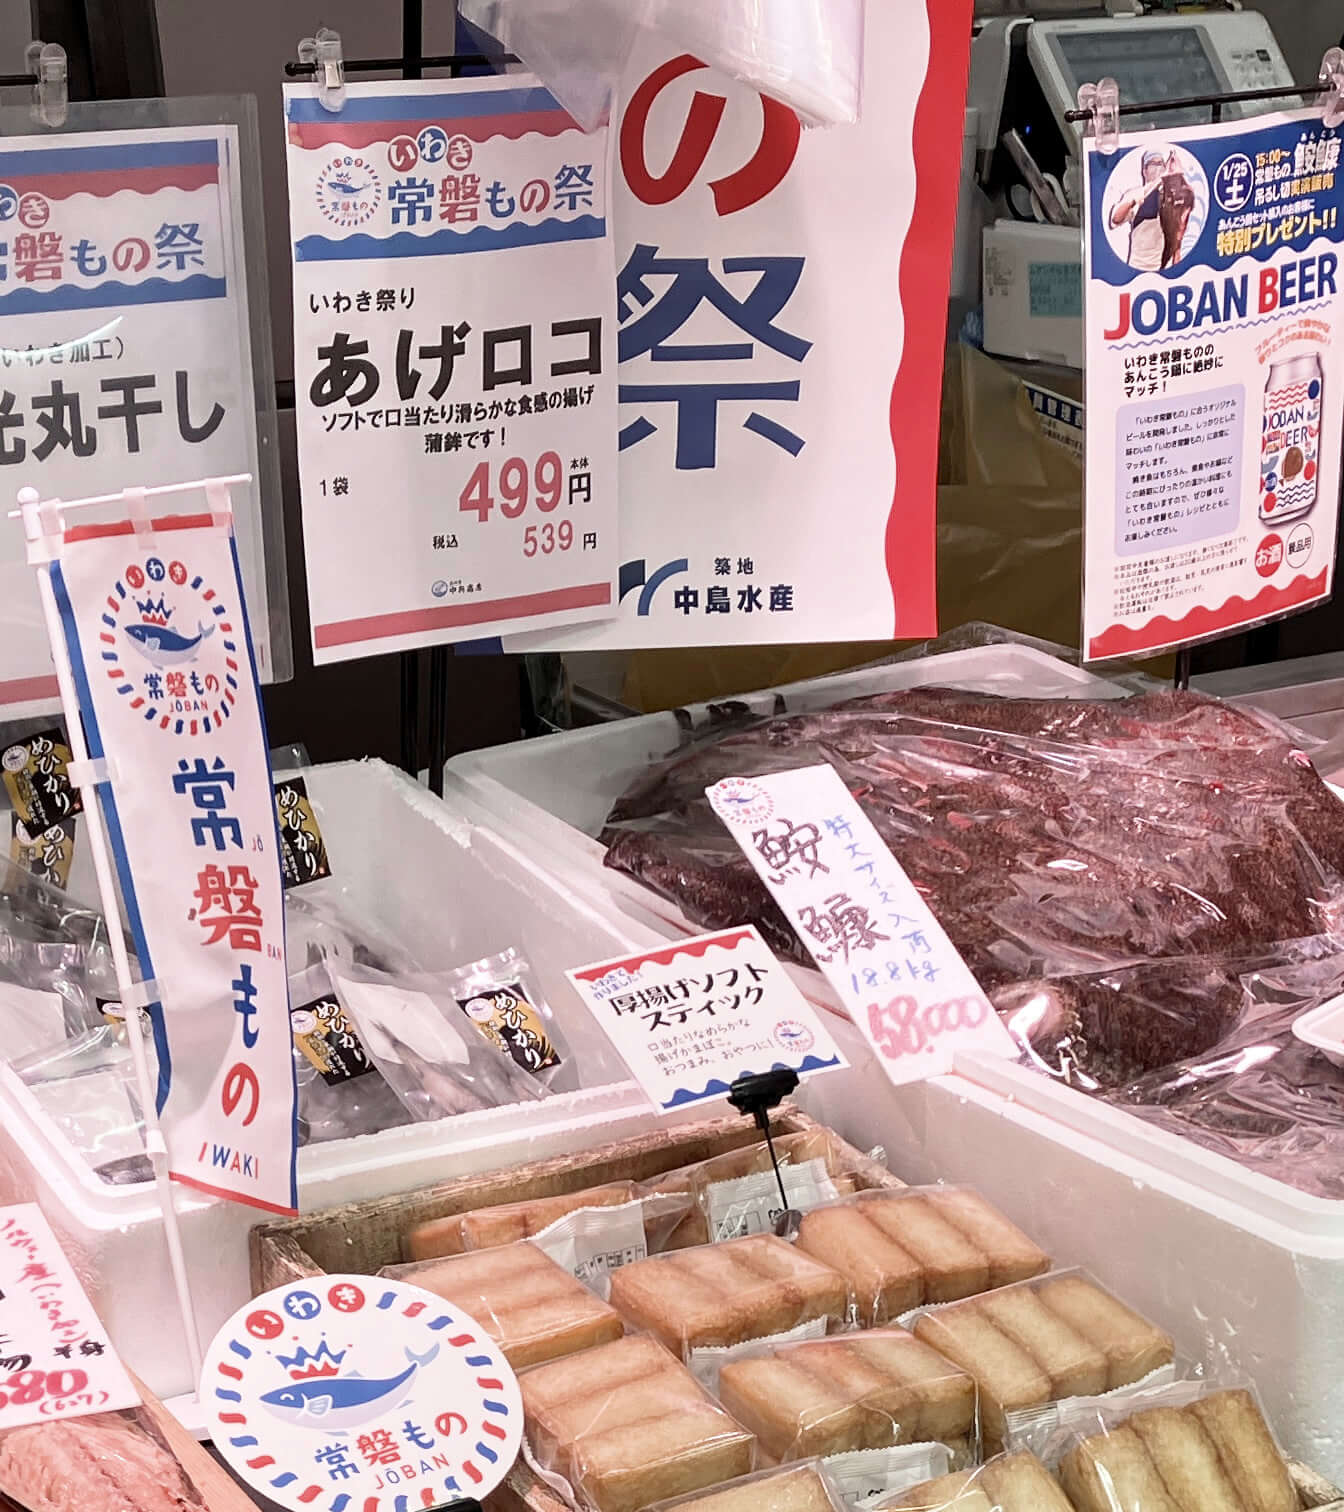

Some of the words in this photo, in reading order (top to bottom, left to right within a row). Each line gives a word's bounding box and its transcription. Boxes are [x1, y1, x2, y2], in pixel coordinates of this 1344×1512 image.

[387, 164, 594, 226] 常磐もの祭
[309, 287, 416, 314] いわき祭り
[1104, 274, 1249, 341] JOBAN
[1258, 252, 1338, 315] BEER
[310, 317, 603, 408] あげロコ
[523, 520, 573, 558] 539
[673, 582, 794, 615] 中島水産
[143, 672, 220, 700] 常磐もの
[280, 786, 318, 877] めひかり
[609, 963, 769, 1016] 厚揚げソフト
[641, 986, 765, 1031] スティック
[494, 993, 542, 1070] めひかり
[246, 1284, 366, 1340] いわき
[314, 1412, 468, 1481] 常磐もの
